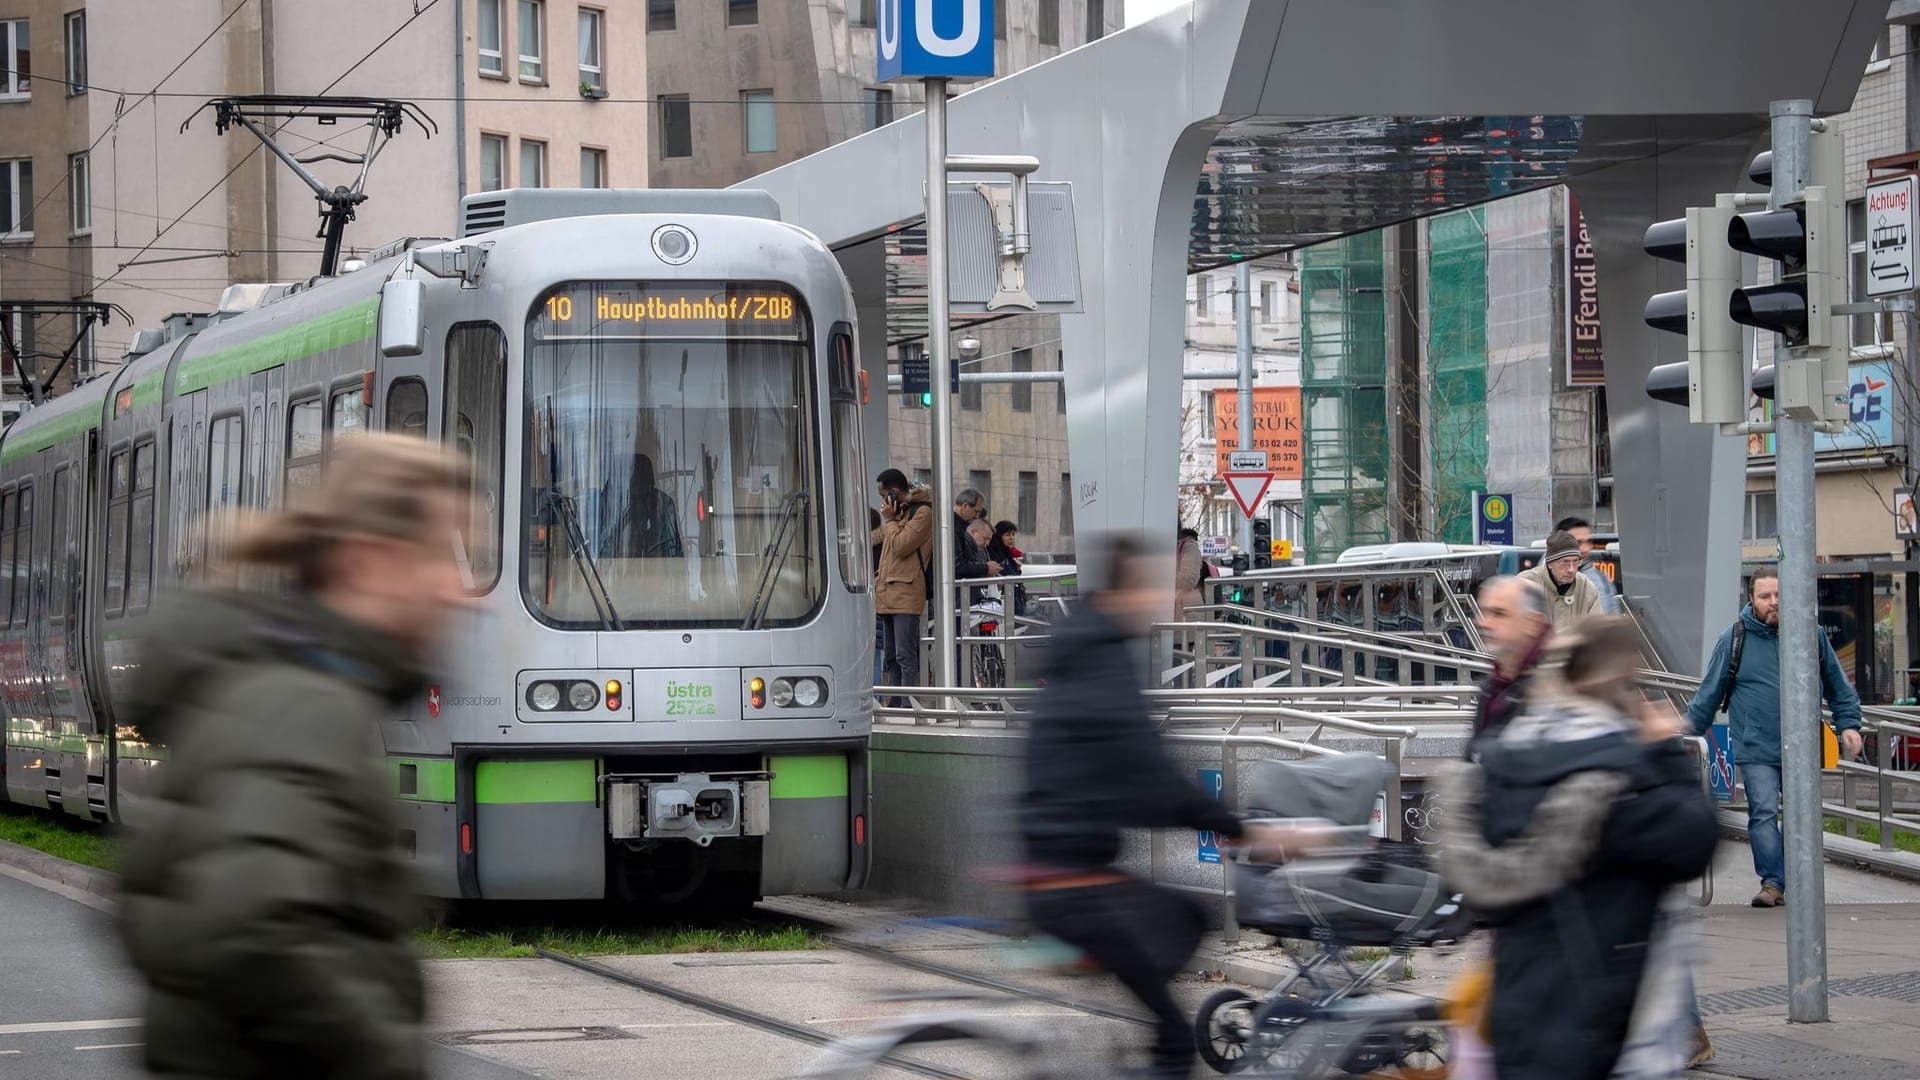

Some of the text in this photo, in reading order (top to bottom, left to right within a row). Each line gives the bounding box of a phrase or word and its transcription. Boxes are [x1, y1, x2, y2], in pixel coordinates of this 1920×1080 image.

[915, 0, 980, 57] U
[1869, 186, 1909, 213] Achtung!
[546, 296, 793, 323] 10 Hauptbahnhof/ZOB
[1574, 264, 1600, 341] Efendi
[1224, 401, 1286, 414] GESTBAU
[1271, 440, 1281, 448] 02
[1283, 440, 1298, 448] 420
[1271, 453, 1281, 461] 55
[1283, 453, 1298, 461] 370
[667, 680, 713, 698] üstra
[666, 700, 716, 715] 2572a
